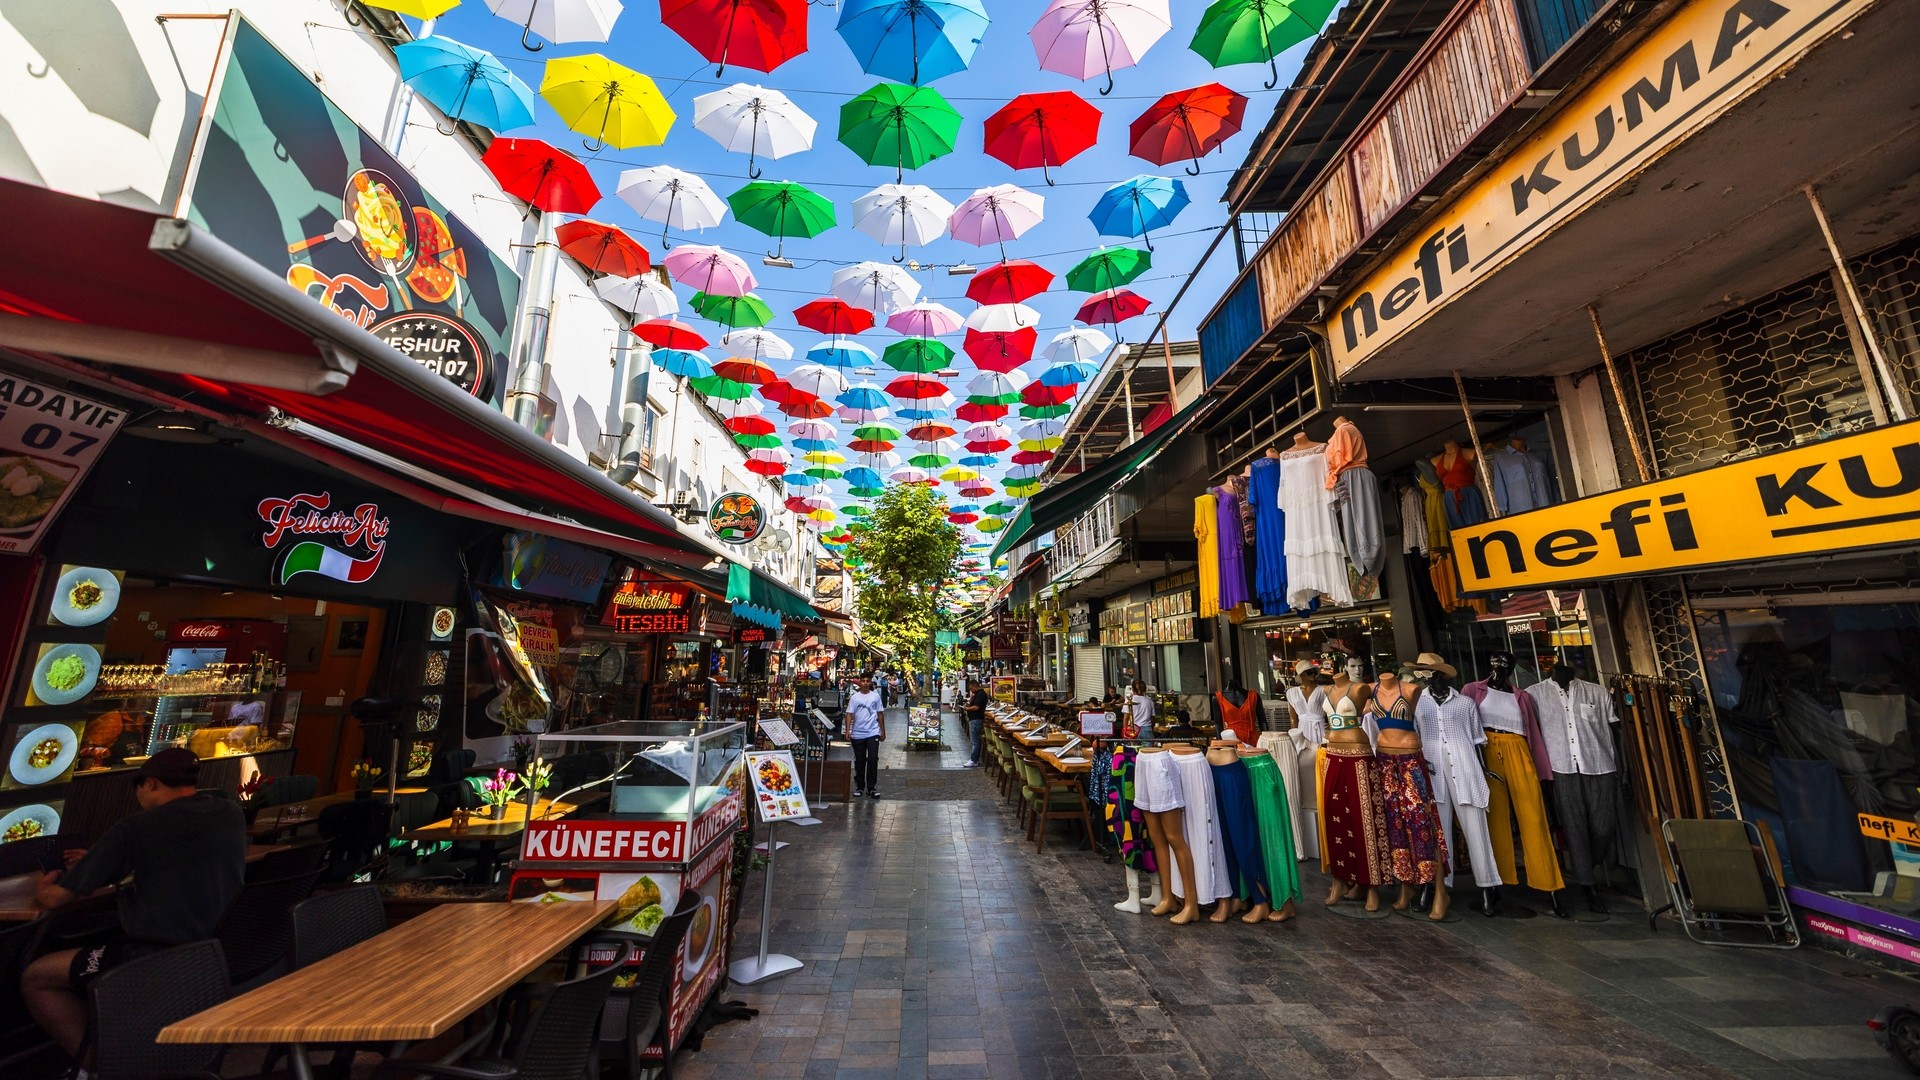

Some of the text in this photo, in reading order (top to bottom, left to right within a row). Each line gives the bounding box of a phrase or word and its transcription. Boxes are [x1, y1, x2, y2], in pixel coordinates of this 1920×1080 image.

[1341, 224, 1470, 353] nefi
[445, 361, 468, 376] 07
[21, 423, 99, 457] 07
[258, 491, 390, 551] Felicita Art
[1467, 443, 1920, 580] nefi KU
[524, 626, 551, 639] DEVREN
[526, 824, 681, 858] KÜNEFECİ
[1860, 817, 1895, 838] nefi
[1810, 919, 1845, 936] maximum
[1857, 933, 1894, 951] maximum
